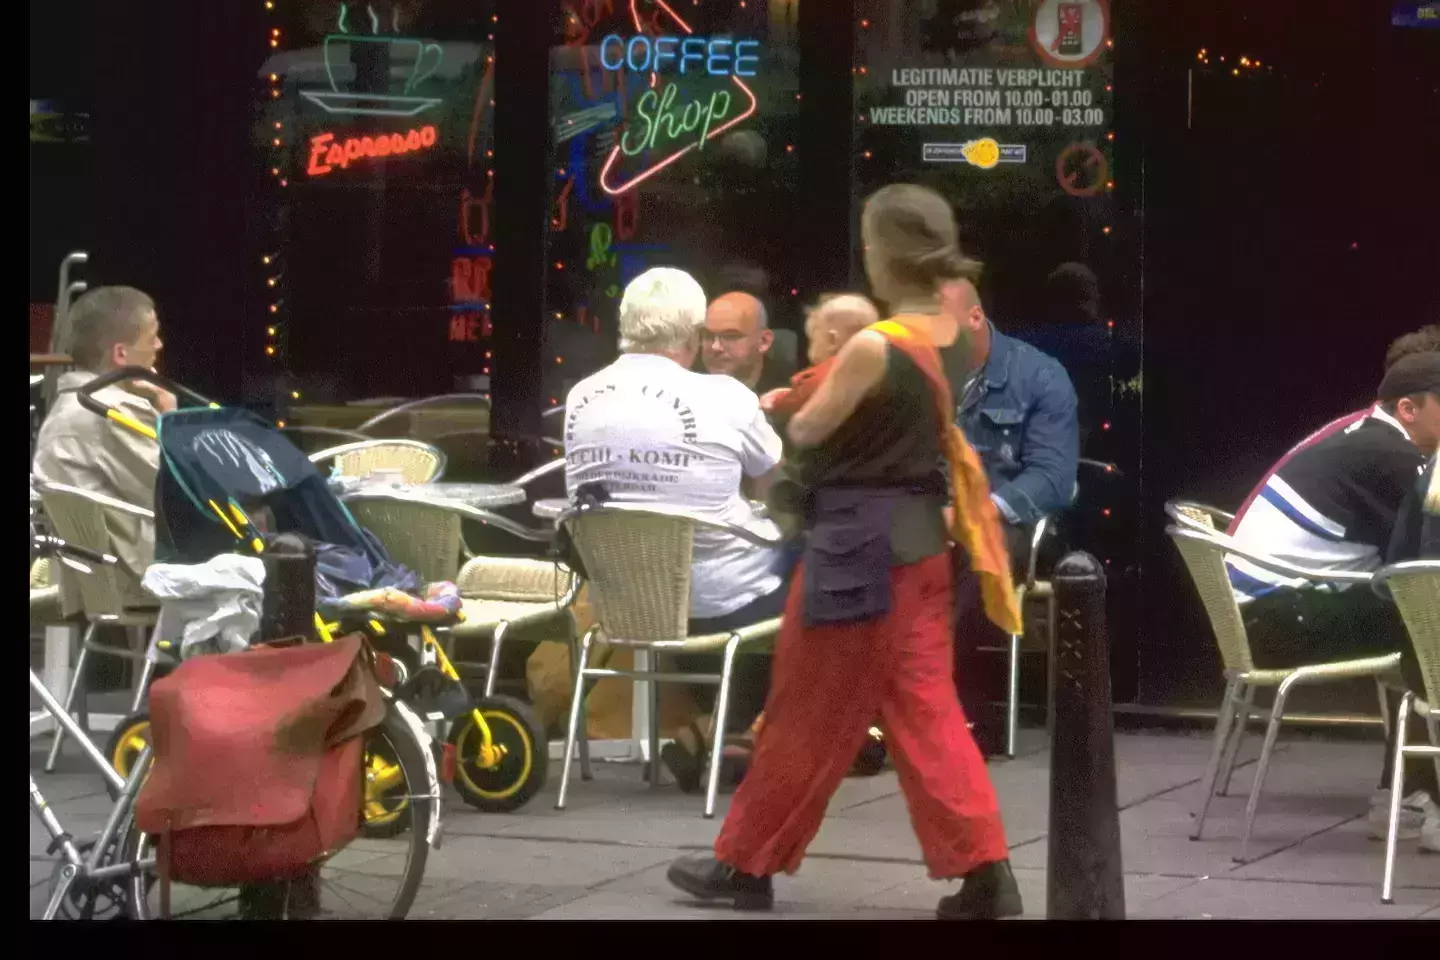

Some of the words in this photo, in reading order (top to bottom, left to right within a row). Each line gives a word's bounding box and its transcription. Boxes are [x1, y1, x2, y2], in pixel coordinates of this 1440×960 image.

[601, 33, 760, 76] COFFEE
[892, 68, 993, 86] LEGITIMATIE
[996, 69, 1084, 87] VERPLICHT
[906, 90, 949, 106] OPEN
[953, 90, 1000, 107] FROM
[621, 82, 731, 157] Shop
[870, 107, 960, 125] WEEKENDS
[964, 108, 1011, 125] FROM
[306, 124, 438, 177] Espresso
